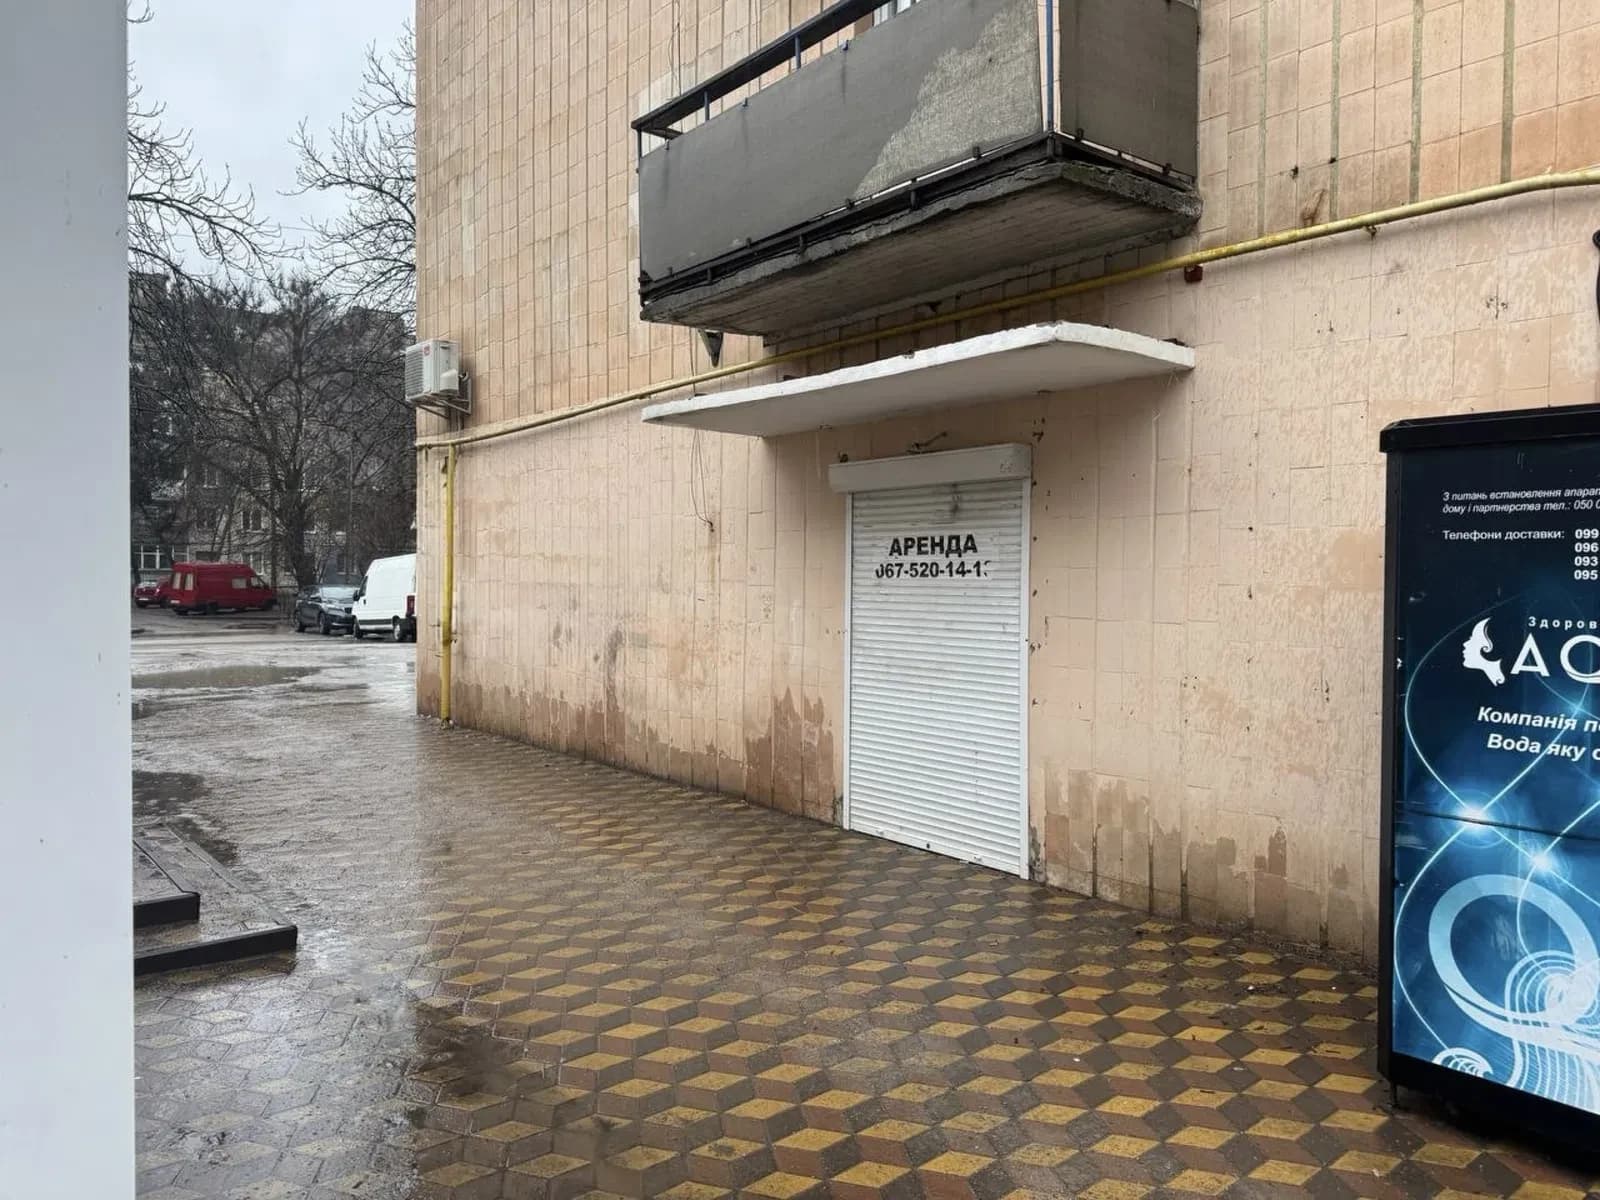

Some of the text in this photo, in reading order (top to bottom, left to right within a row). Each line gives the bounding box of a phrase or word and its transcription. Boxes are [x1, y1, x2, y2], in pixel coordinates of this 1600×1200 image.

[1451, 492, 1488, 501] питань
[1489, 489, 1562, 500] встановлення
[1442, 503, 1466, 515] дому
[1472, 503, 1541, 514] партнерства
[1573, 499, 1594, 510] 050
[1442, 528, 1600, 542] Телефони доставки: 099
[888, 533, 978, 558] АРЕНДА
[1574, 542, 1599, 553] 096
[1574, 556, 1599, 567] 093
[1573, 569, 1598, 581] 095
[1477, 706, 1600, 733] Компанія п
[1487, 733, 1541, 754] Вода
[1546, 743, 1587, 762] яку
